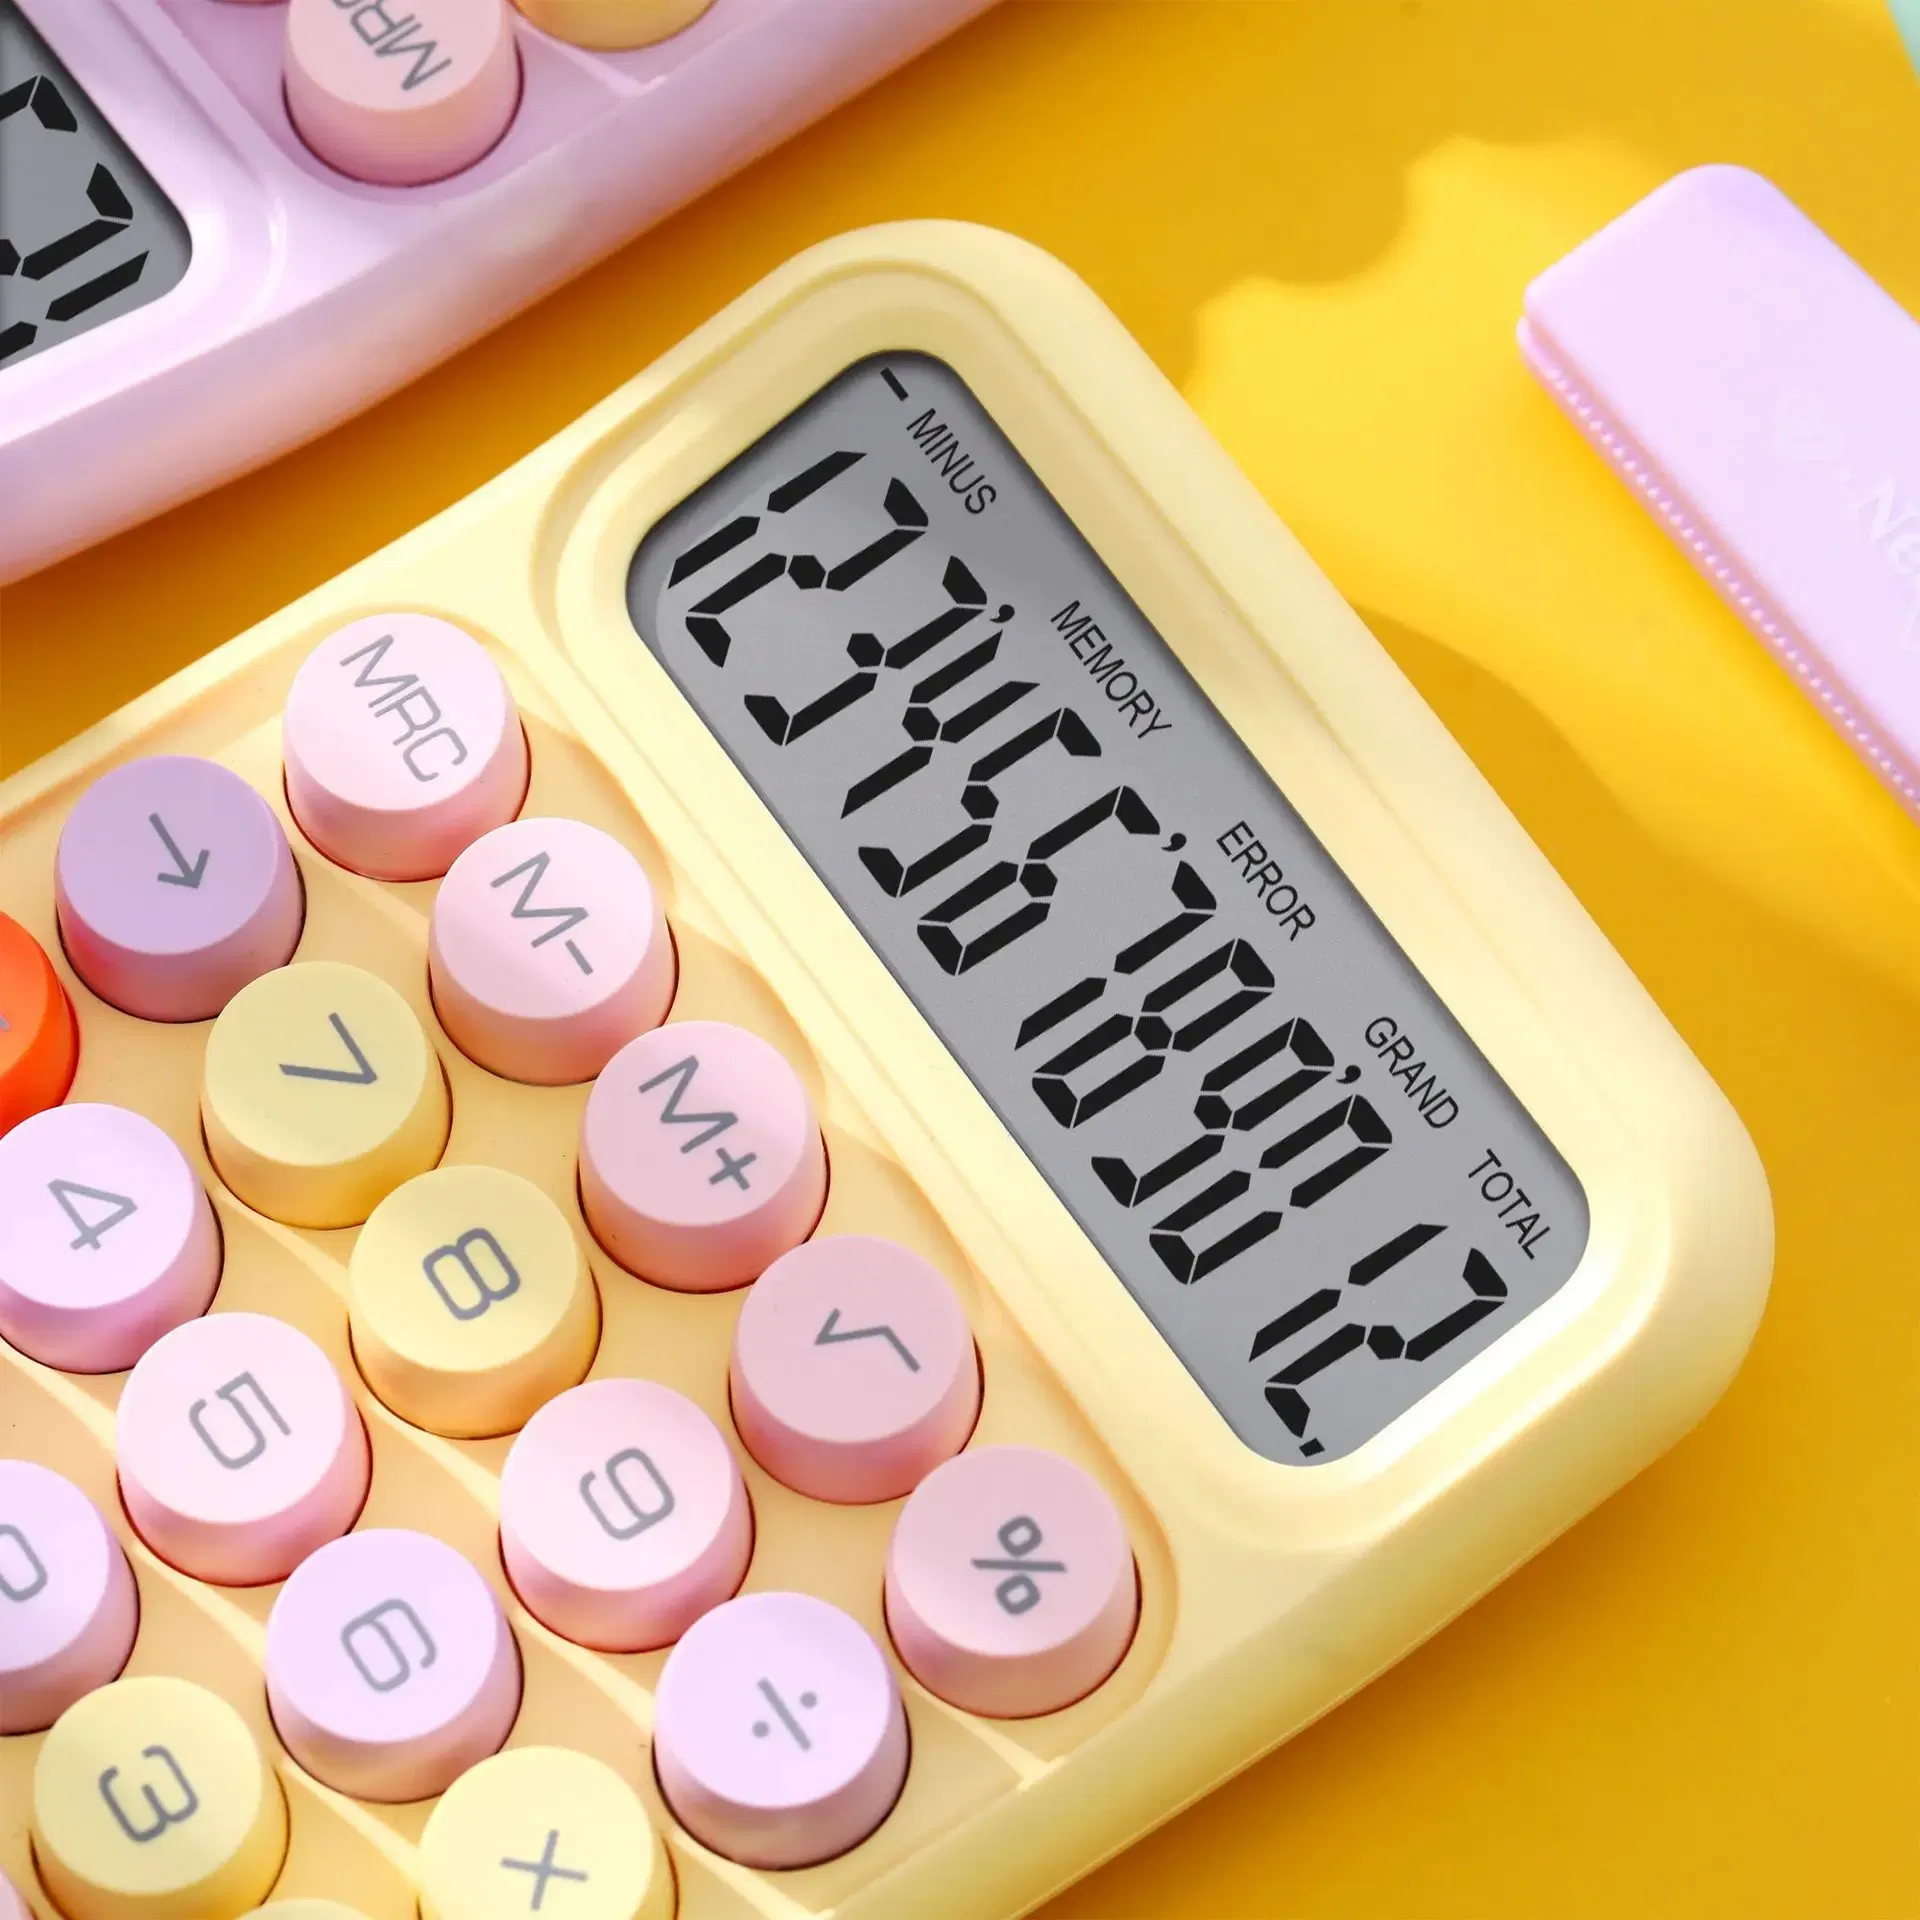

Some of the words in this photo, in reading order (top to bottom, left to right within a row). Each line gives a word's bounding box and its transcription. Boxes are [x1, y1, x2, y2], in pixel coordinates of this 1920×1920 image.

[332, 0, 452, 91] MR
[906, 408, 996, 515] MINUS
[339, 634, 468, 782] MRC
[1050, 600, 1173, 741] MEMORY
[490, 852, 594, 976] M-
[1216, 821, 1316, 941] ERROR
[279, 1012, 378, 1085] 7
[638, 1055, 758, 1191] M+
[1364, 1016, 1459, 1130] GRAND
[1466, 1149, 1553, 1261] TOTAL
[47, 1178, 138, 1251] 4
[422, 1227, 521, 1321] 8
[188, 1371, 292, 1470] 5
[579, 1447, 675, 1540] 9
[970, 1515, 1066, 1616] %
[340, 1598, 437, 1693] 6
[98, 1744, 199, 1845] 3
